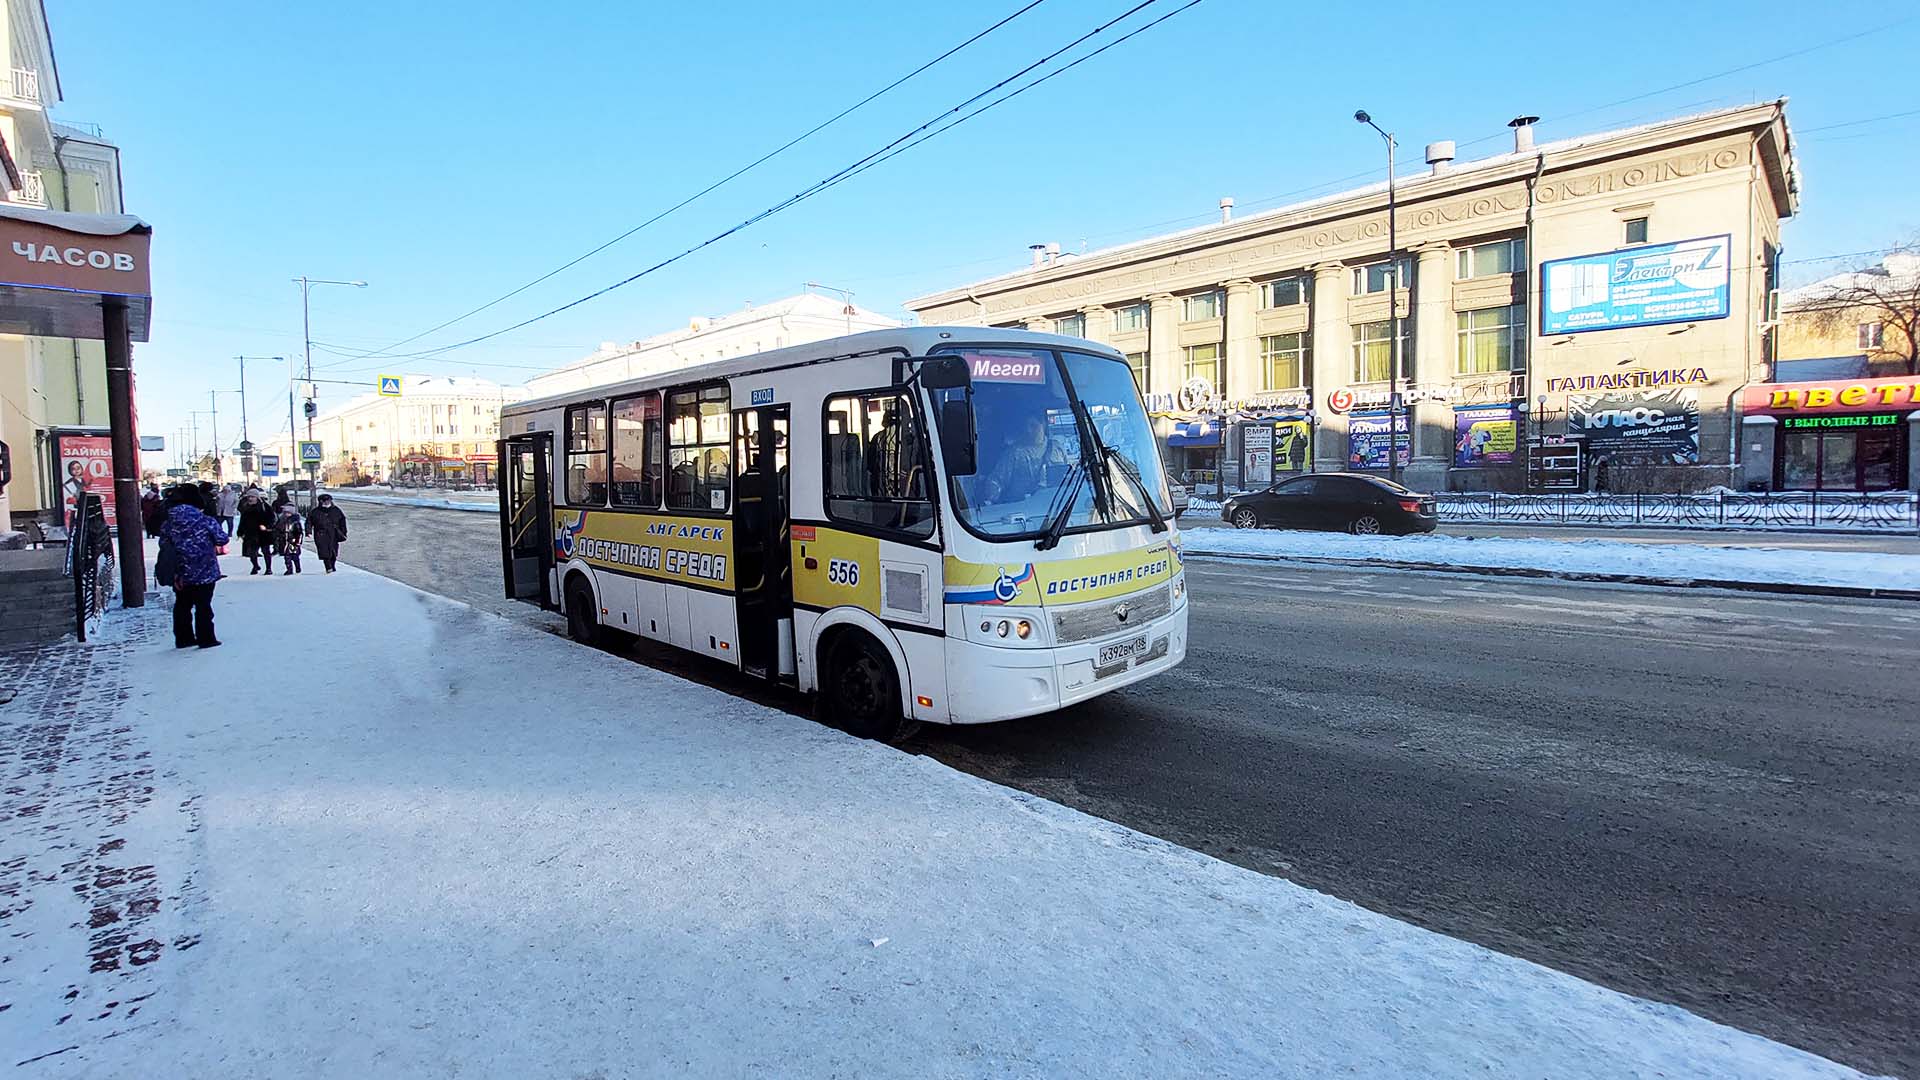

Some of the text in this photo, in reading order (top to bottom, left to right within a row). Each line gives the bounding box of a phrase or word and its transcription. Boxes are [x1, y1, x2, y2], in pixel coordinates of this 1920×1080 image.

[12, 241, 135, 271] ЧАСОВ
[973, 360, 1040, 376] Мегет
[1550, 367, 1709, 392] ГАЛАКТИКА
[752, 389, 772, 402] ВХОД
[1623, 423, 1686, 438] канцелярия
[1794, 416, 1869, 427] ВЫГОДНЫЕ
[646, 523, 725, 541] АНГАРСК
[578, 537, 726, 582] ДОСТУПНАЯ СРЕДА
[828, 558, 860, 586] 556
[1047, 560, 1167, 595] ДОСТУПНАЯ СРЕДА
